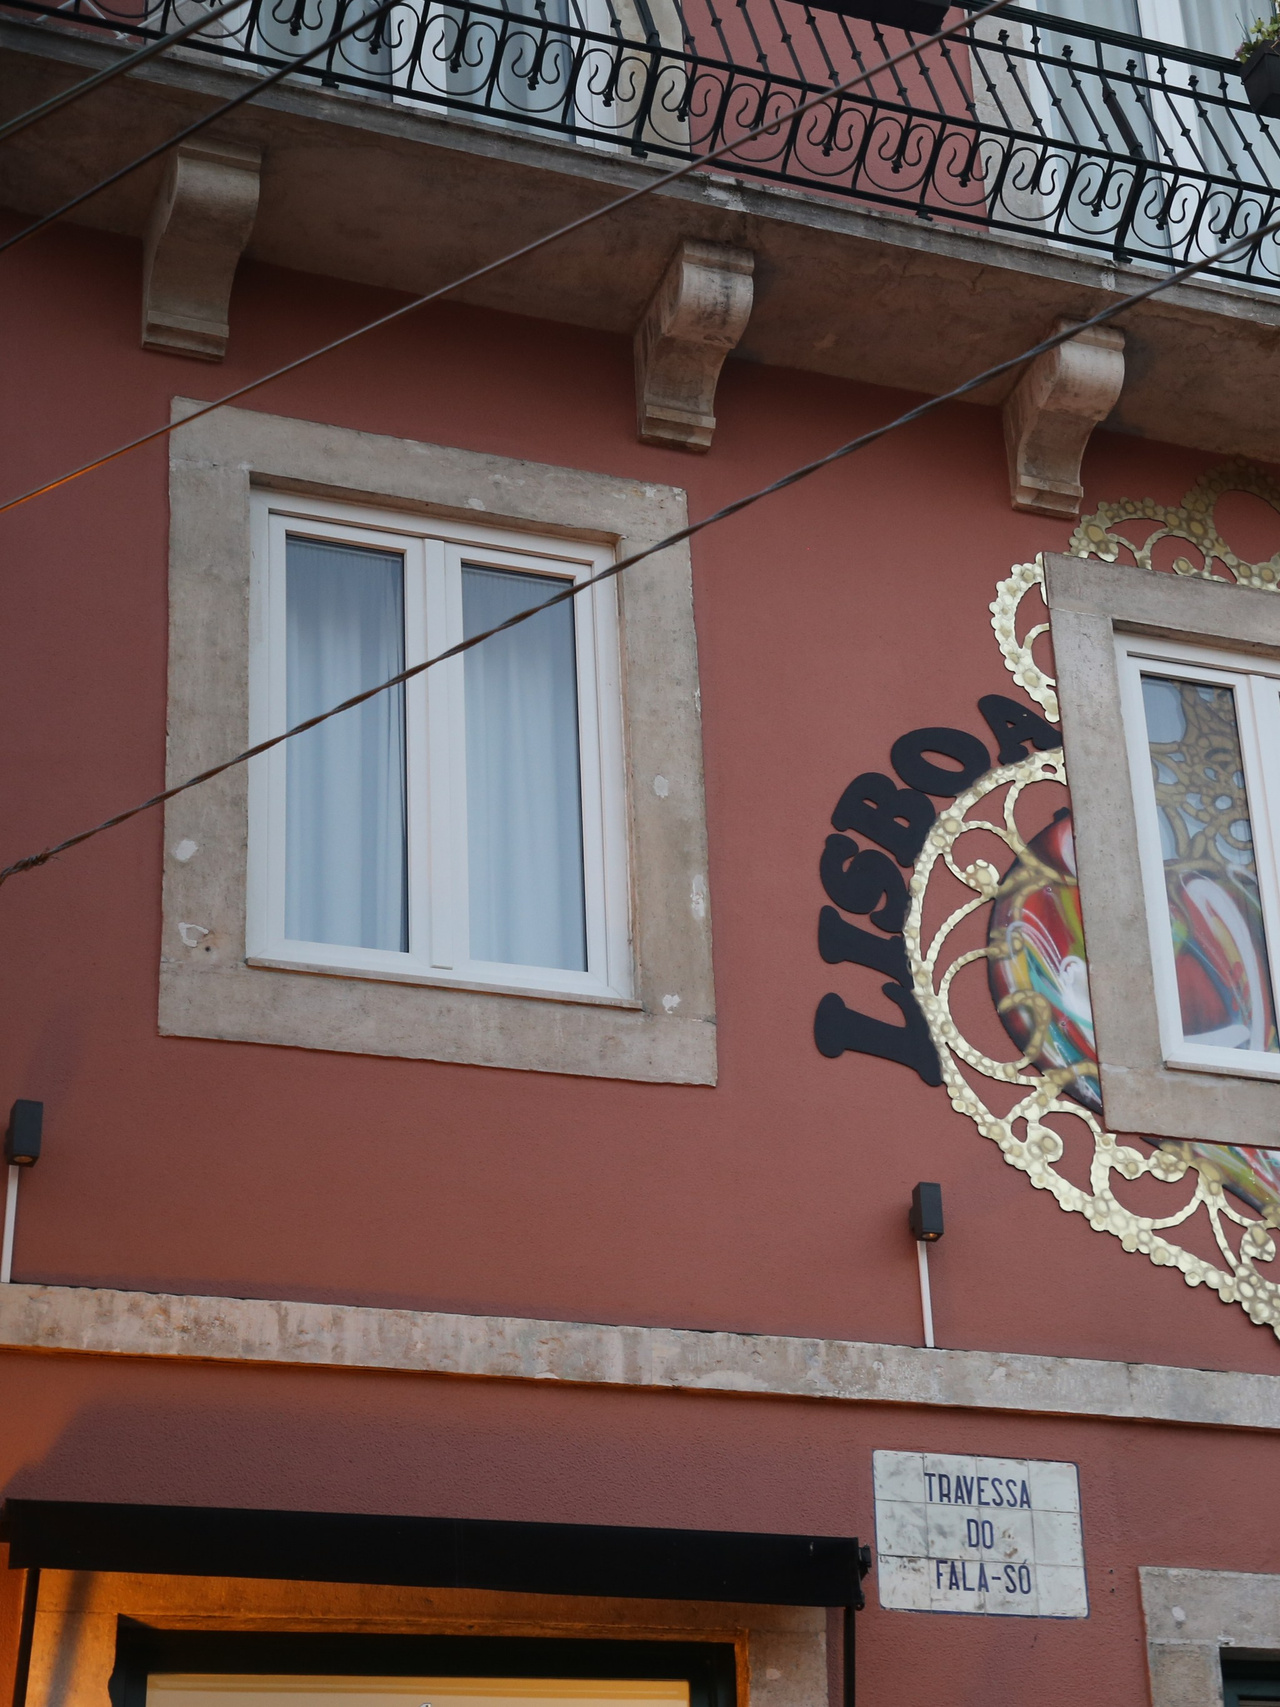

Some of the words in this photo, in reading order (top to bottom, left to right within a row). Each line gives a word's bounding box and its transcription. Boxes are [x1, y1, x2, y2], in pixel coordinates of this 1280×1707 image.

[814, 694, 1062, 1086] LISBOA
[924, 1473, 1031, 1509] TRAVESSA
[967, 1519, 994, 1549] DO
[936, 1559, 1031, 1594] FALA-SÓ
